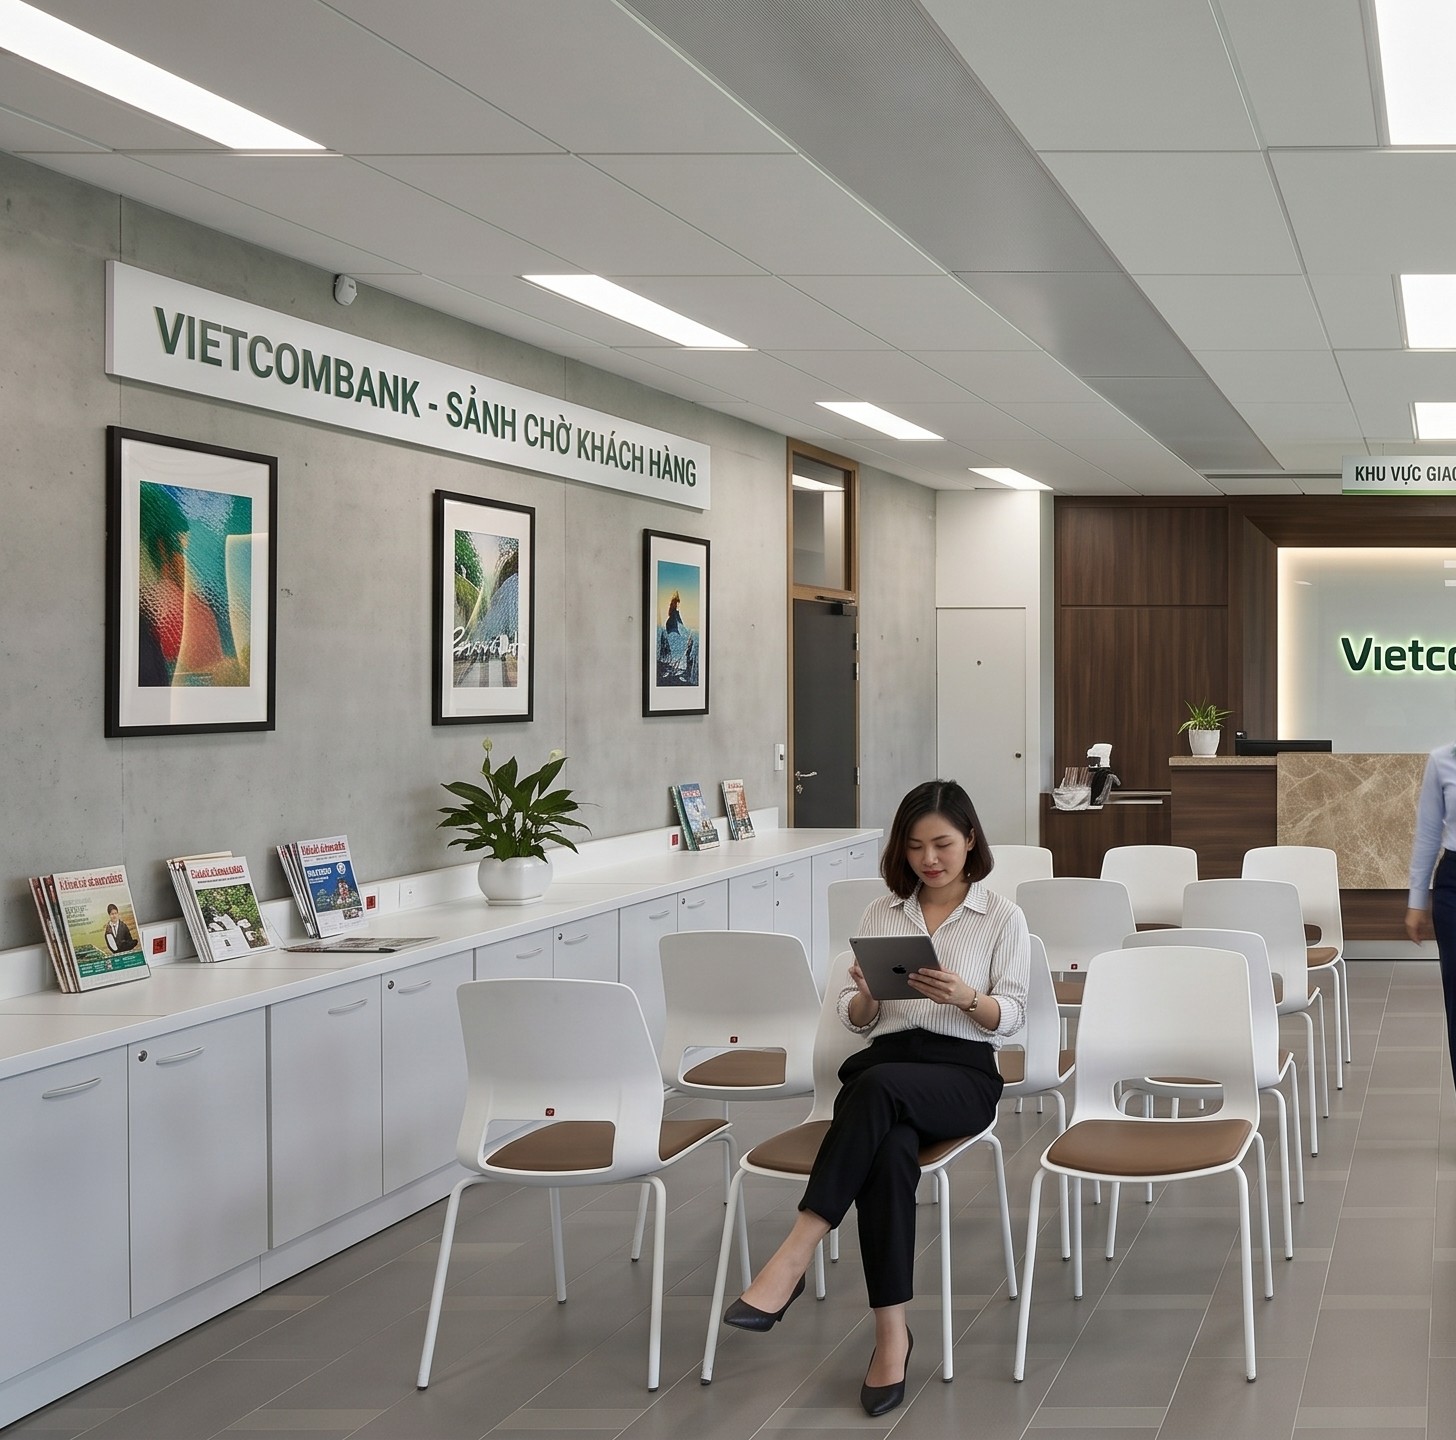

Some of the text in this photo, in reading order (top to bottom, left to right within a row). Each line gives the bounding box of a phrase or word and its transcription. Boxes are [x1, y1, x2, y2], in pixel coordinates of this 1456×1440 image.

[154, 306, 420, 418] VIETCOMBANK
[446, 385, 516, 442] SẢNH
[524, 414, 573, 455] CHỜ
[577, 431, 644, 474] KHÁCH
[649, 445, 697, 487] HÀNG
[1355, 466, 1386, 482] KHU
[1391, 464, 1421, 485] VỰC
